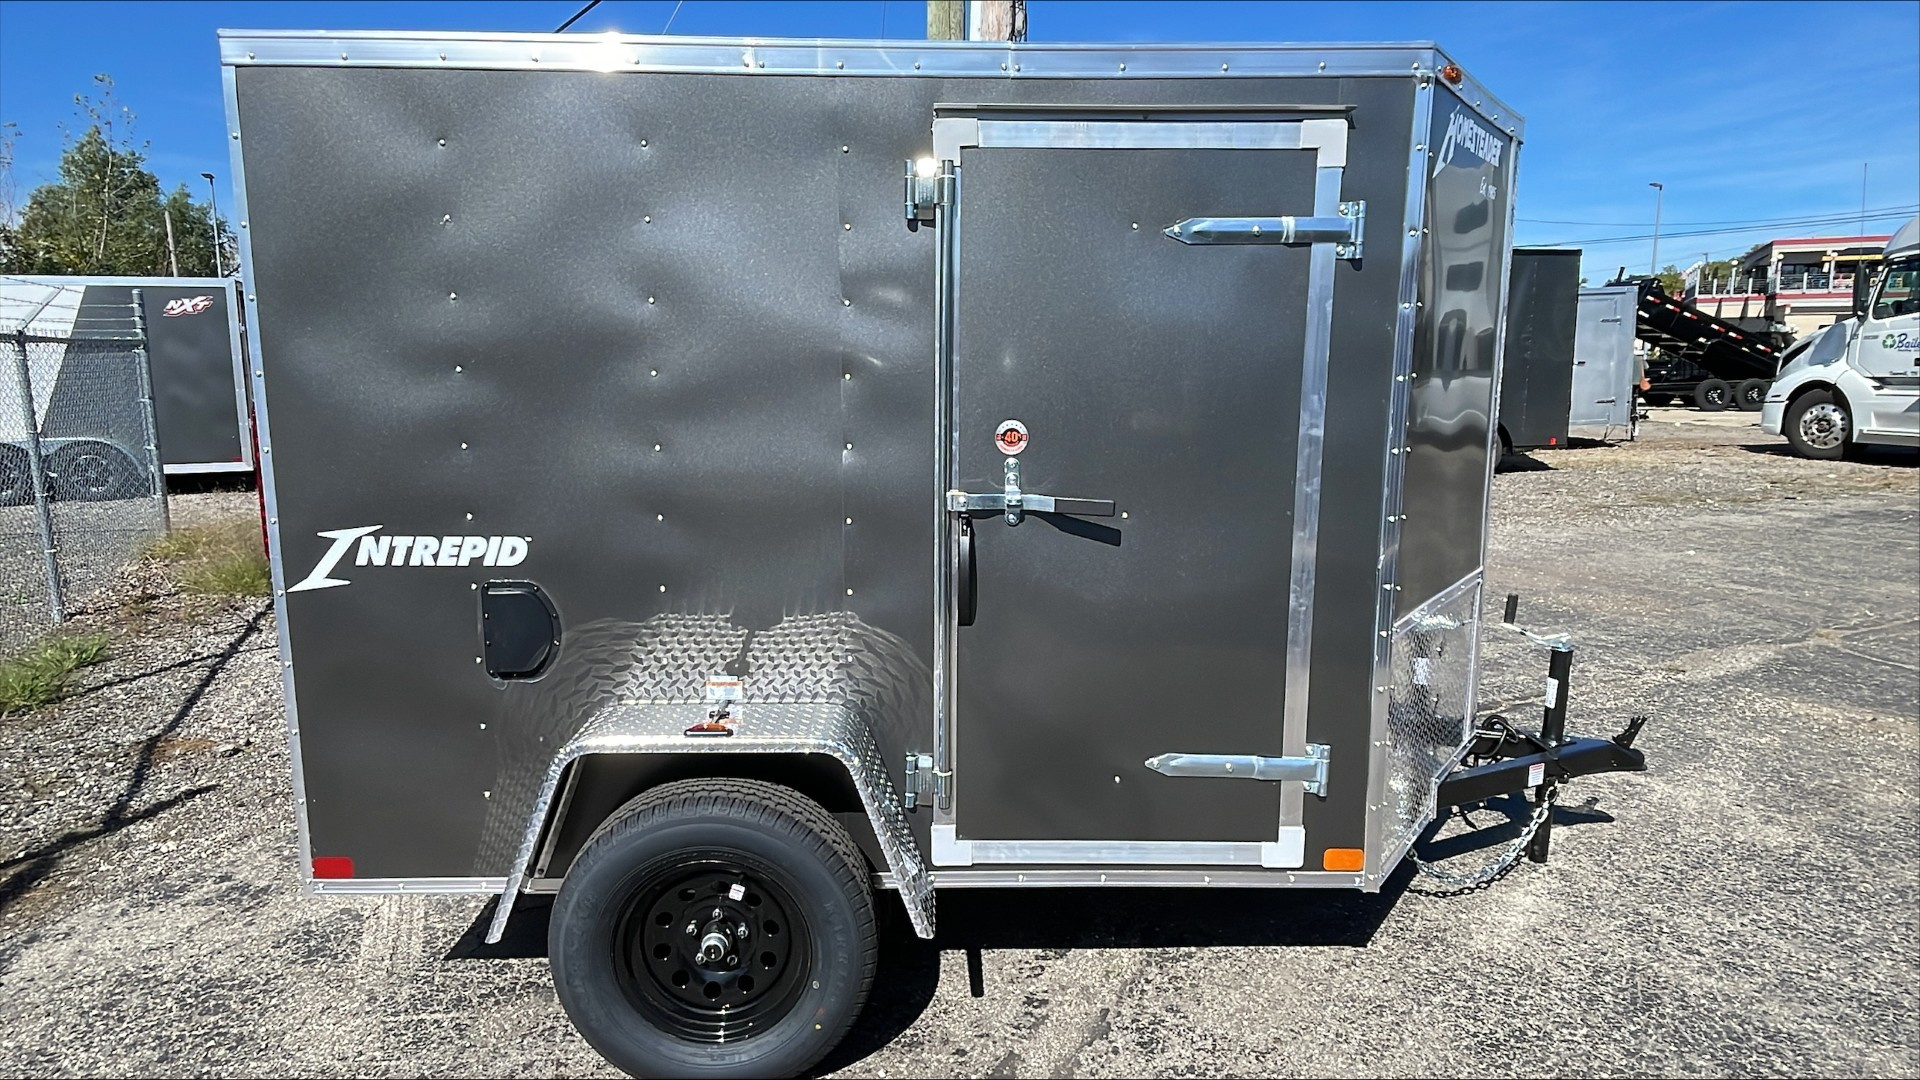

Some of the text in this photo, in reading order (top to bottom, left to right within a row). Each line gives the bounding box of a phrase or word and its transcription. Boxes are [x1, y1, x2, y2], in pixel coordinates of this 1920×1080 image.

[163, 296, 213, 316] NXT
[1004, 431, 1019, 442] 40
[286, 524, 529, 593] INTREPID
